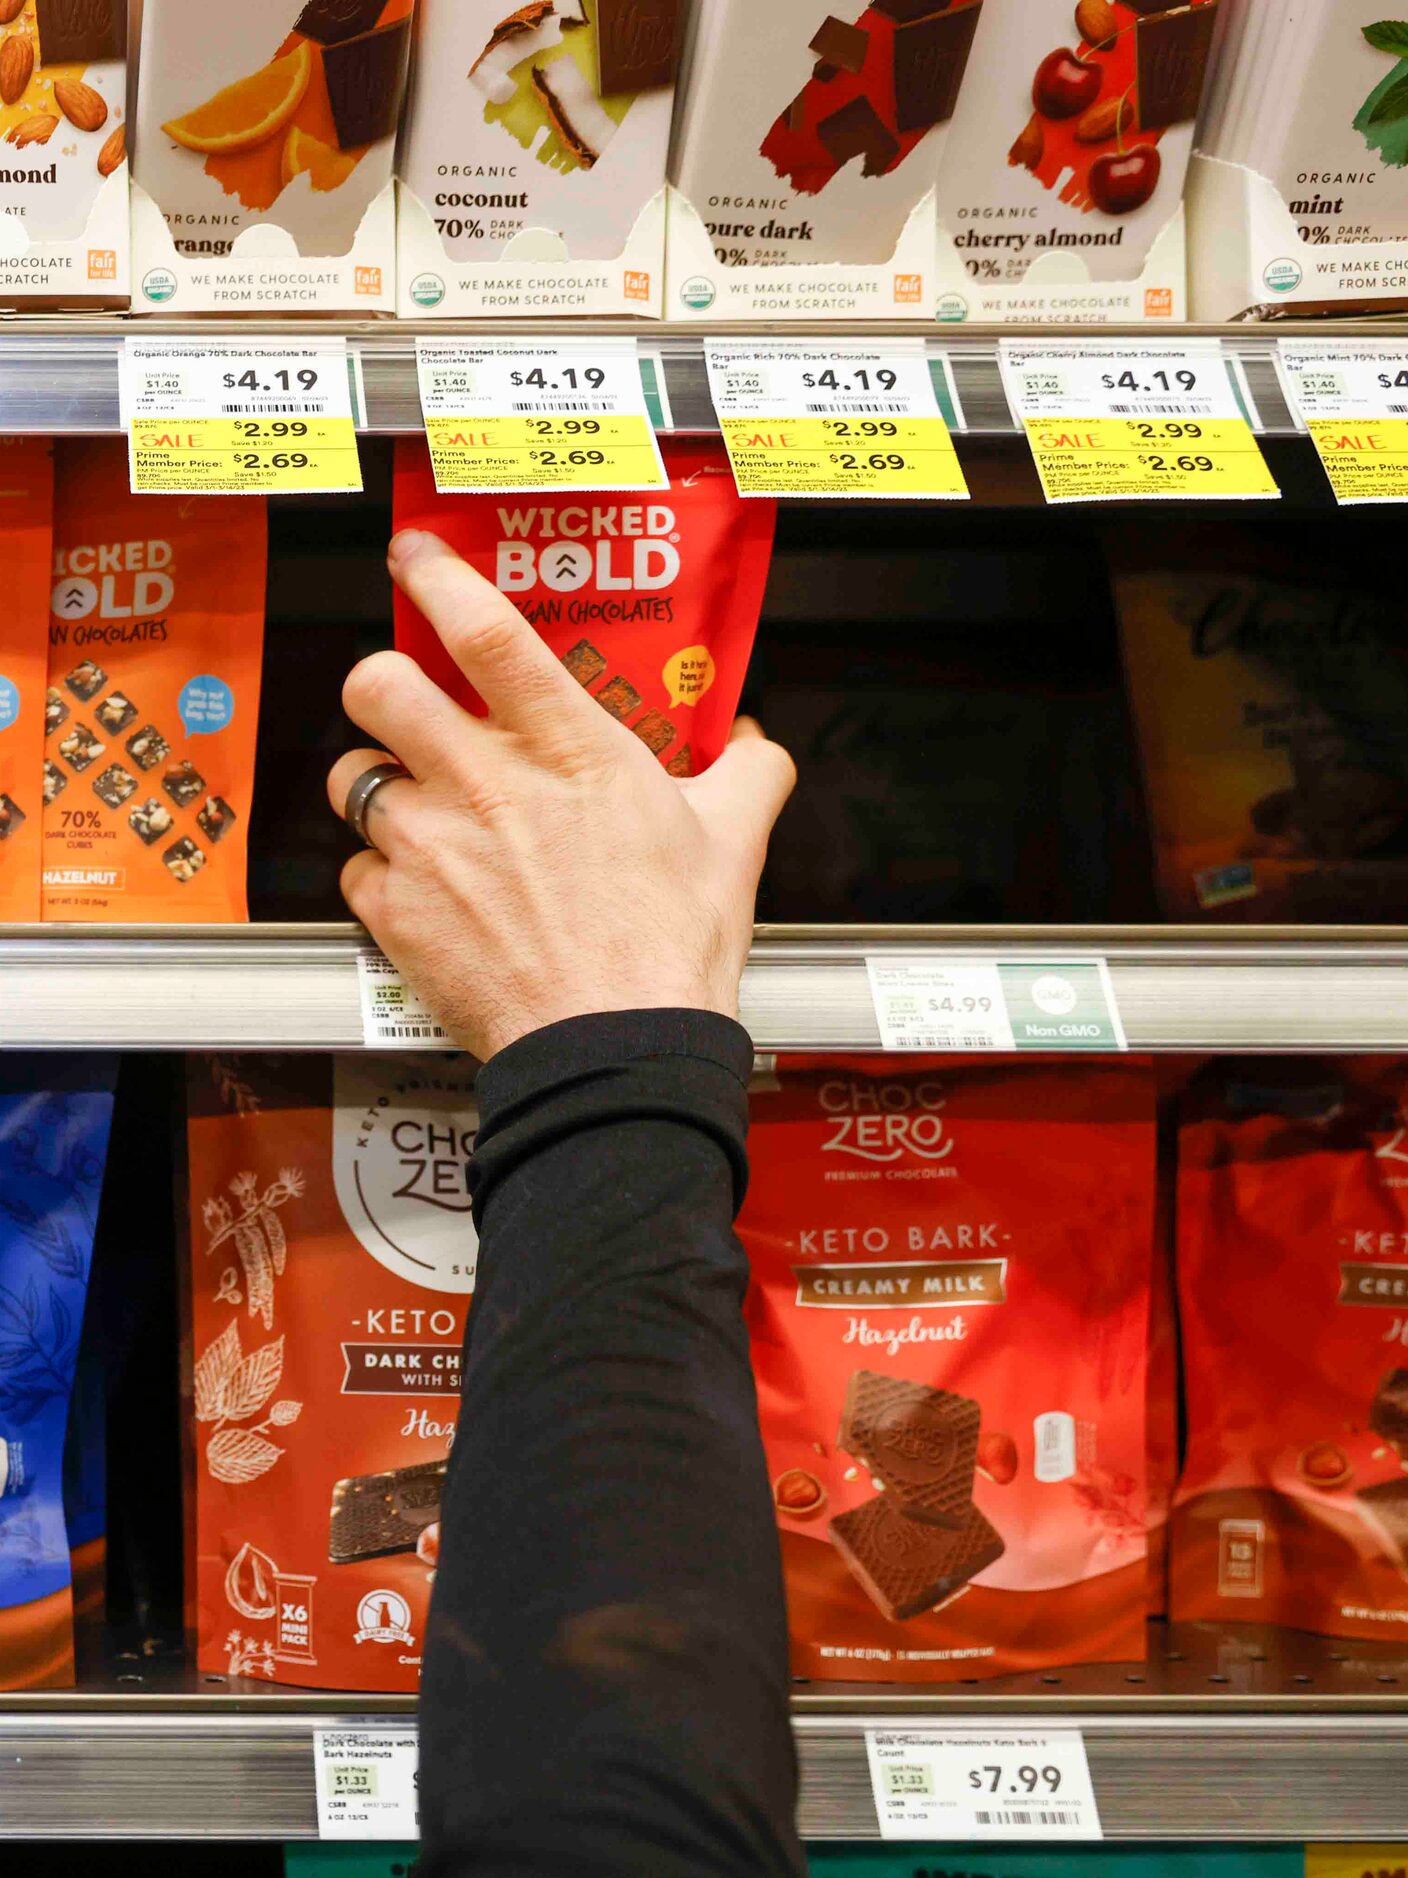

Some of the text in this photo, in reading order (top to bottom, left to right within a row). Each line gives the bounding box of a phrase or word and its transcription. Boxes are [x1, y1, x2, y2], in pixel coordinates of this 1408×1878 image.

[437, 165, 518, 178] ORGANIC
[1297, 173, 1376, 184] ORGANIC
[435, 190, 529, 208] coconut
[1289, 194, 1344, 214] mint
[760, 220, 815, 240] dark
[954, 227, 1123, 250] cherry almond
[222, 370, 318, 391] $4.19
[510, 368, 605, 389] $4.19
[802, 369, 897, 391] $4.19
[1101, 370, 1196, 392] $4.19
[234, 421, 307, 437] $2.99
[525, 419, 600, 434] $2.99
[822, 421, 897, 436] $2.99
[1126, 421, 1202, 438] $2.99
[140, 434, 204, 447] SALE
[1319, 435, 1387, 450] SALE
[137, 460, 222, 468] Member Price:
[234, 453, 308, 468] $2.69
[529, 450, 604, 465] $2.69
[830, 454, 905, 470] $2.69
[1138, 454, 1214, 471] $2.69
[497, 506, 675, 538] WICKED
[496, 540, 680, 592] BOLD
[50, 575, 174, 619] OLD
[568, 597, 674, 625] CHOCOLATES
[74, 621, 168, 645] CHOCOLATES
[60, 810, 102, 829] 70%
[42, 869, 116, 884] HAZELNUT
[929, 997, 991, 1013] $4.99
[1026, 1025, 1100, 1037] Non GMO
[818, 1082, 946, 1112] CHOC
[821, 1115, 953, 1161] ZERO
[814, 1274, 985, 1296] CREAMY MILK
[841, 1315, 968, 1356] Hazelnut
[365, 1354, 421, 1369] DARK
[402, 1374, 442, 1387] WITH
[282, 1603, 308, 1621] X6
[282, 1623, 308, 1635] MINI
[281, 1634, 308, 1645] PACK
[336, 1777, 367, 1786] $1.33
[969, 1766, 1061, 1793] $7.99
